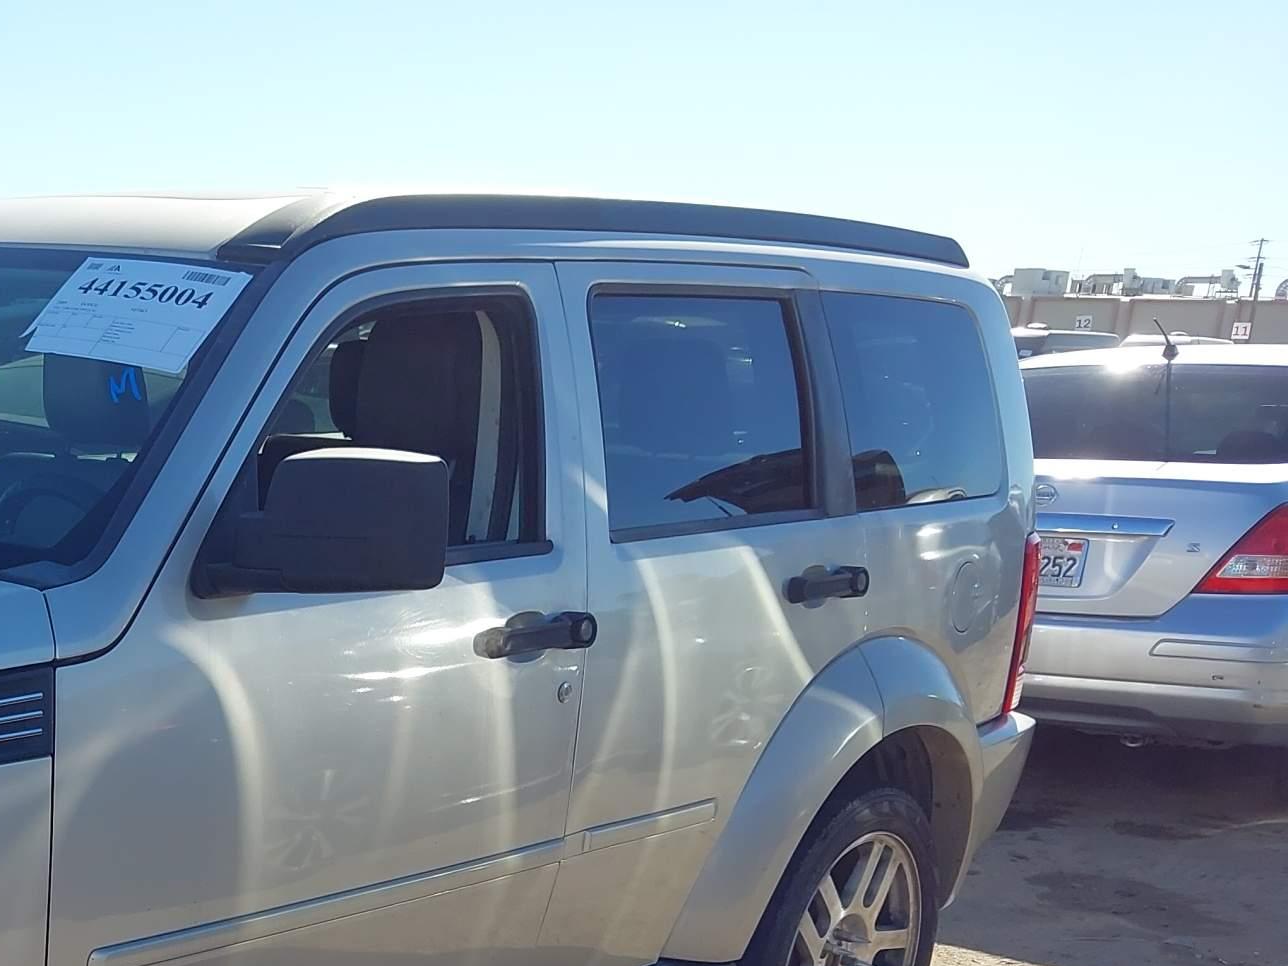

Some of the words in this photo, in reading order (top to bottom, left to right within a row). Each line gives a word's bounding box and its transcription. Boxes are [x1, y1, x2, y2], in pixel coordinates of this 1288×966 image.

[78, 278, 214, 309] 44155004
[1076, 318, 1091, 329] 12
[1233, 326, 1249, 336] 11
